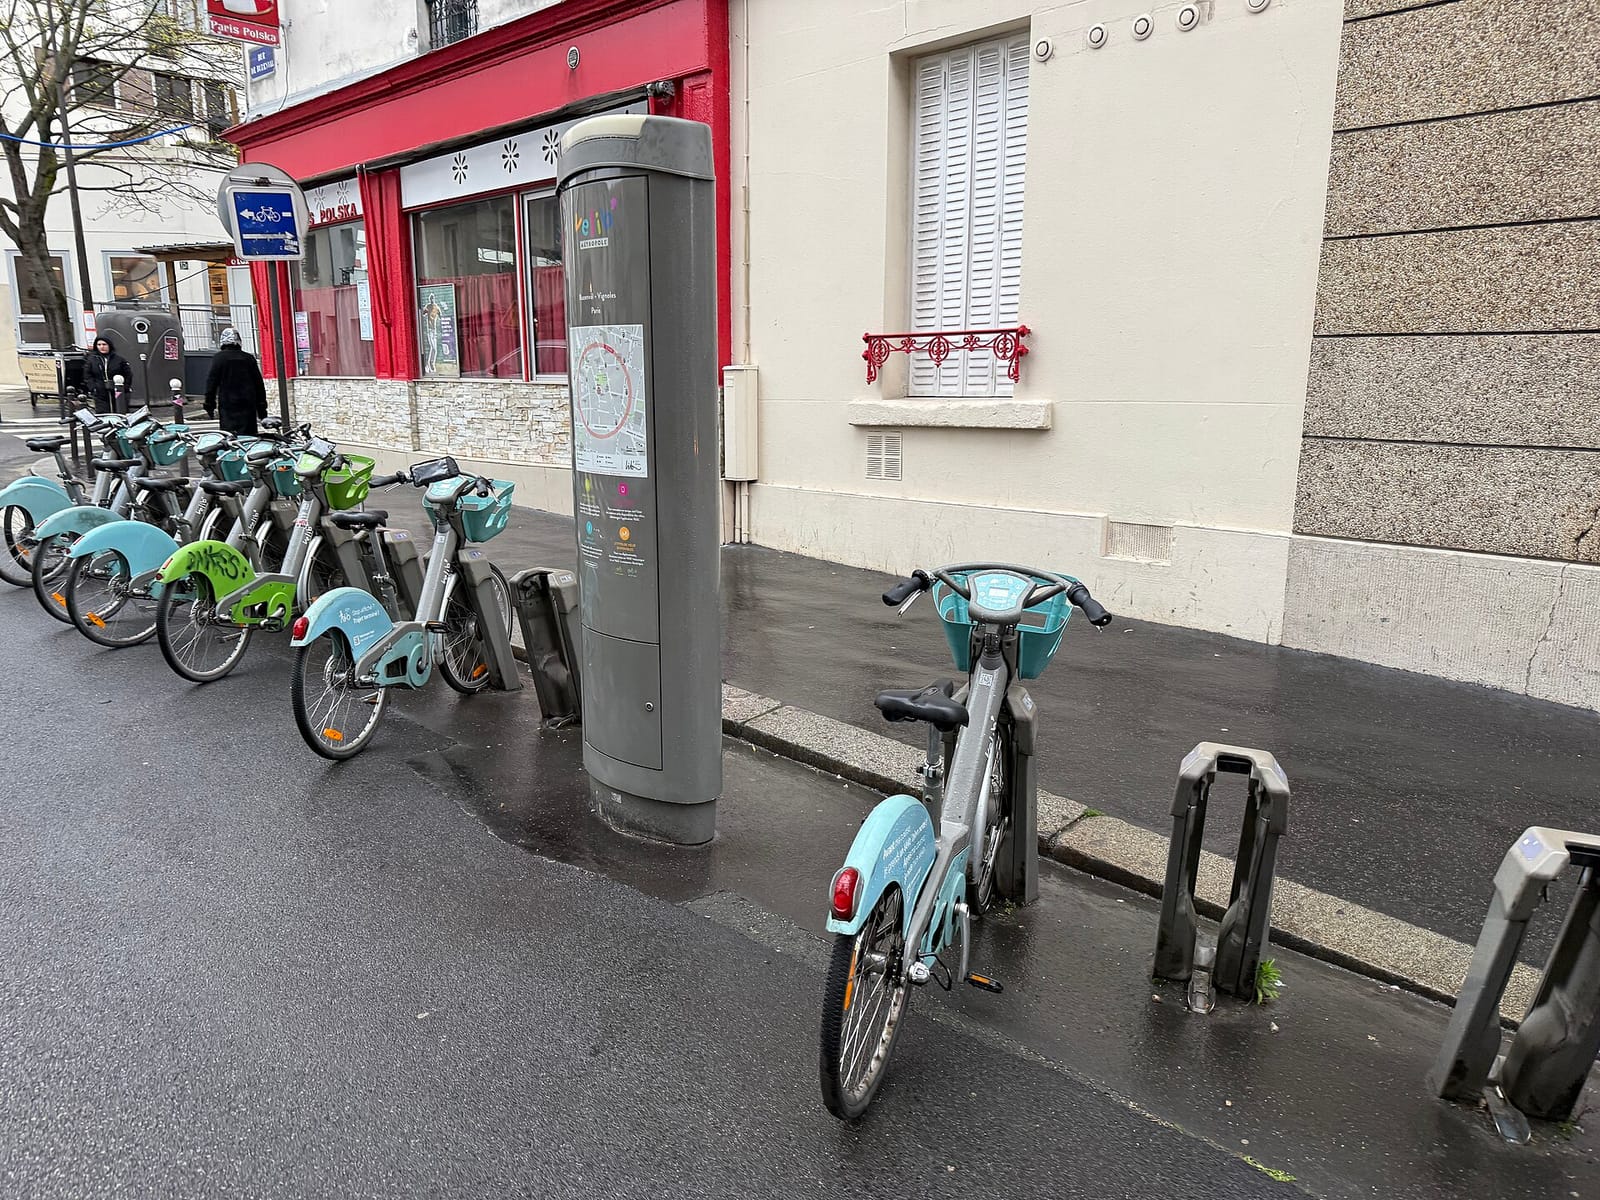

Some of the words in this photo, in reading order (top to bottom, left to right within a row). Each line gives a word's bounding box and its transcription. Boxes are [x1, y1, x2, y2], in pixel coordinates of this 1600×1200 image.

[210, 20, 240, 35] Paris
[242, 27, 277, 42] Polska
[320, 202, 358, 223] POLSKA
